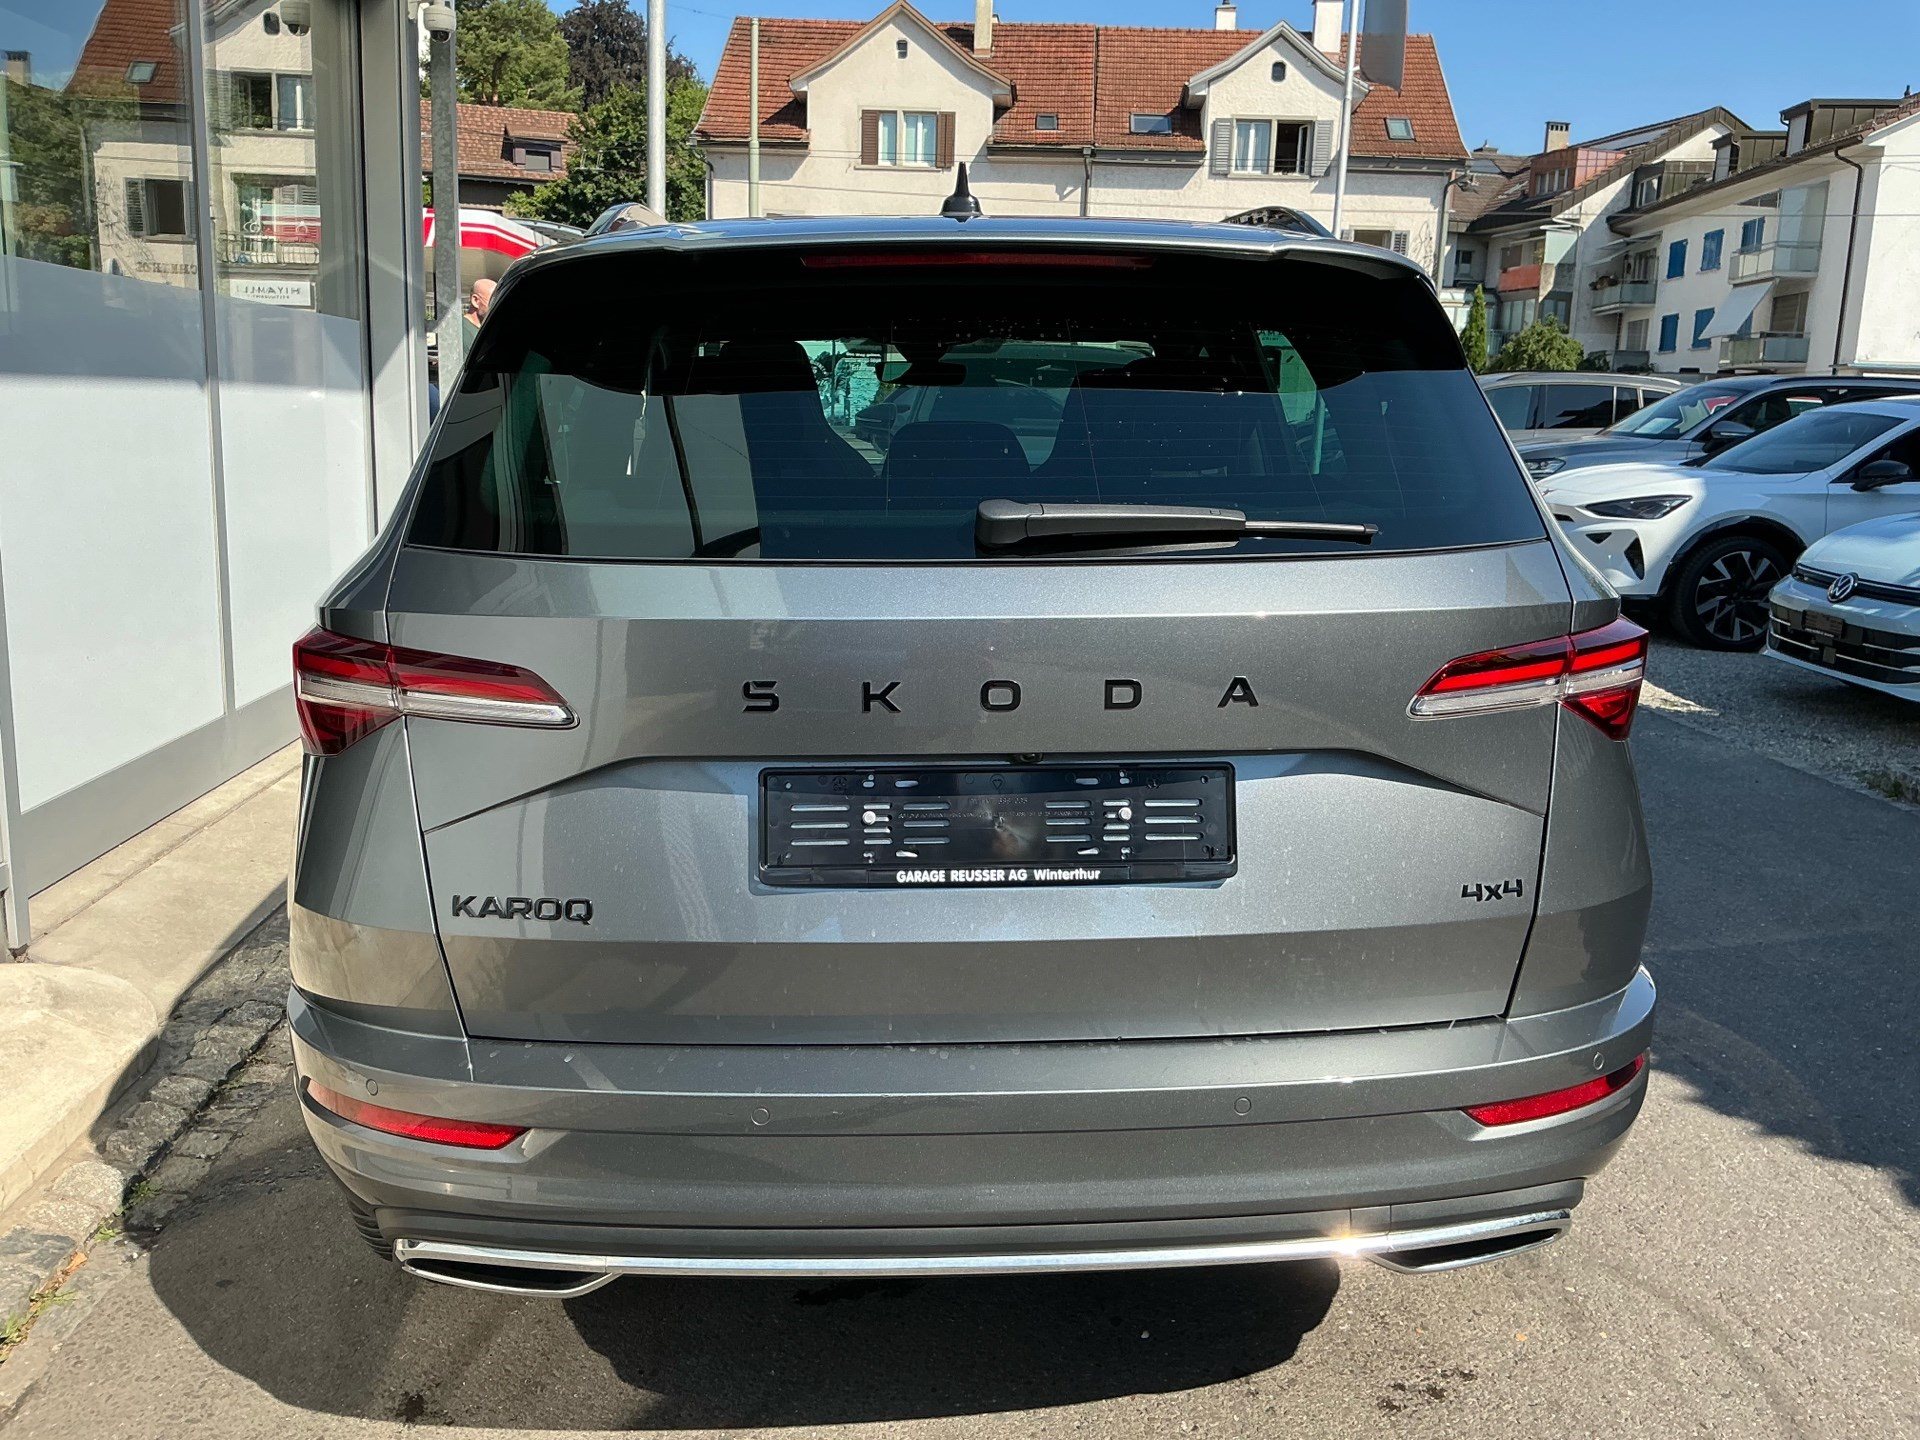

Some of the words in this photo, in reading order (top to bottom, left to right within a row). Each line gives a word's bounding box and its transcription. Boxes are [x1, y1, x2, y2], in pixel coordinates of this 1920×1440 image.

[896, 870, 946, 882] GARAGE
[950, 869, 1005, 882] REUSSER
[1008, 869, 1028, 881] AG
[1033, 868, 1101, 881] Winterthur
[1461, 878, 1523, 902] 4x4
[452, 894, 595, 926] KAROQ
